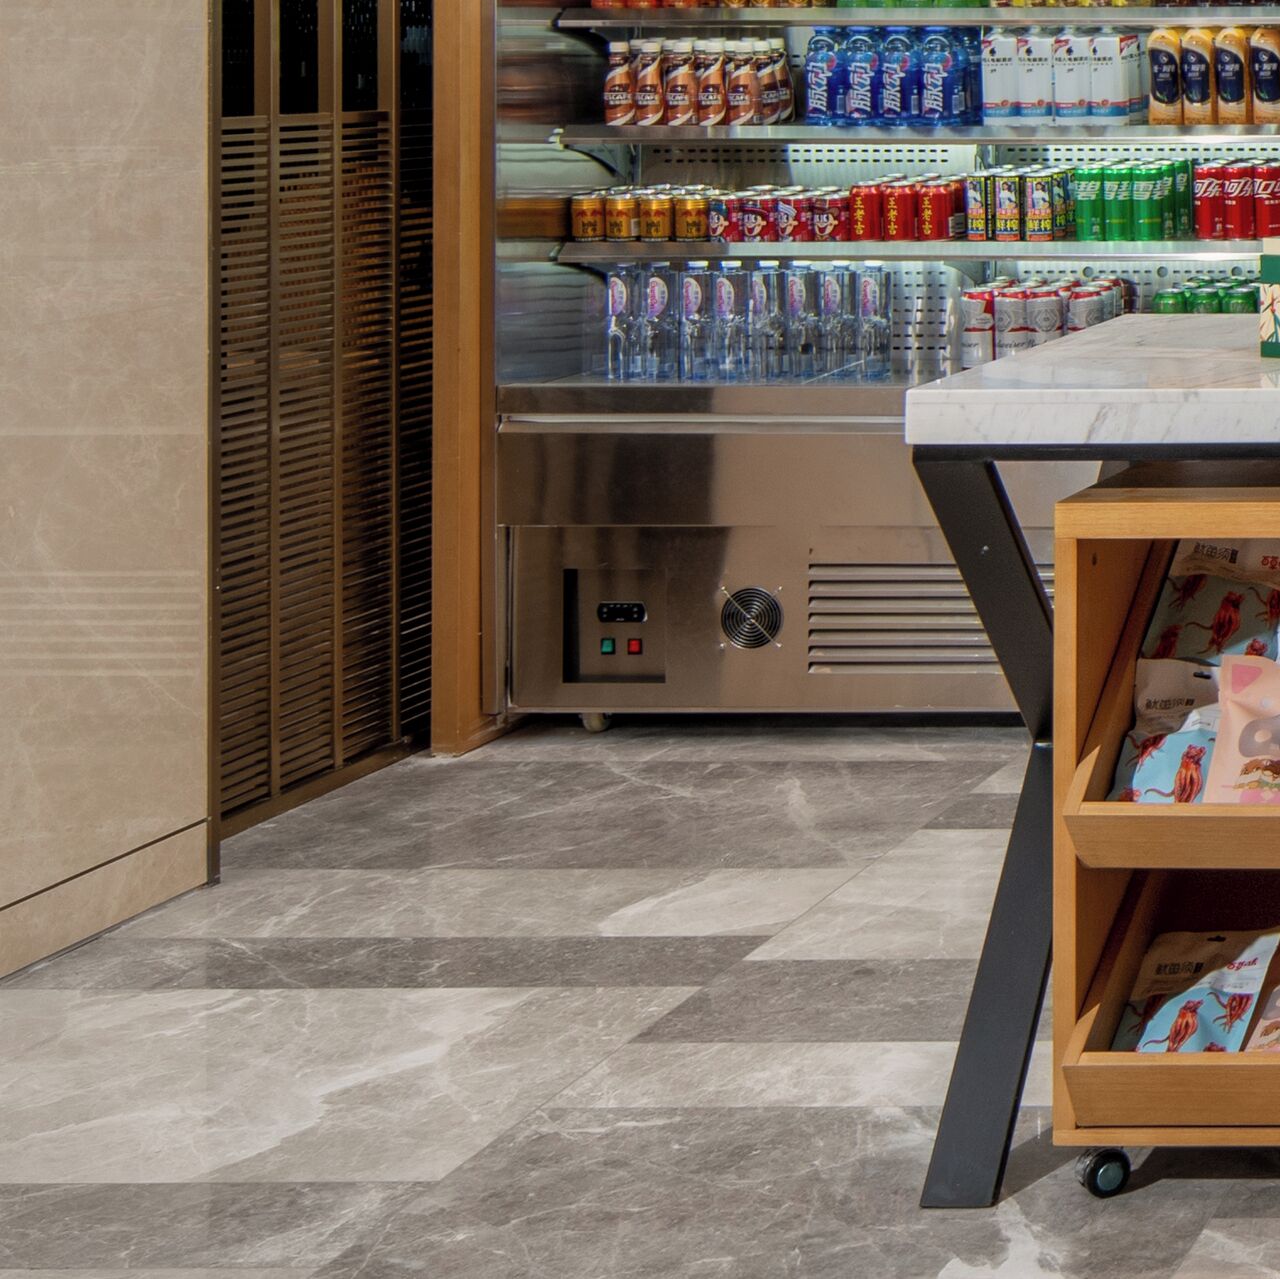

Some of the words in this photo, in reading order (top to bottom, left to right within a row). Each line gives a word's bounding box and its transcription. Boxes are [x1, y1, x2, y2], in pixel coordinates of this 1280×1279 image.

[854, 197, 865, 235] 王老吉
[887, 197, 898, 235] 王老吉
[921, 197, 933, 235] 王老吉
